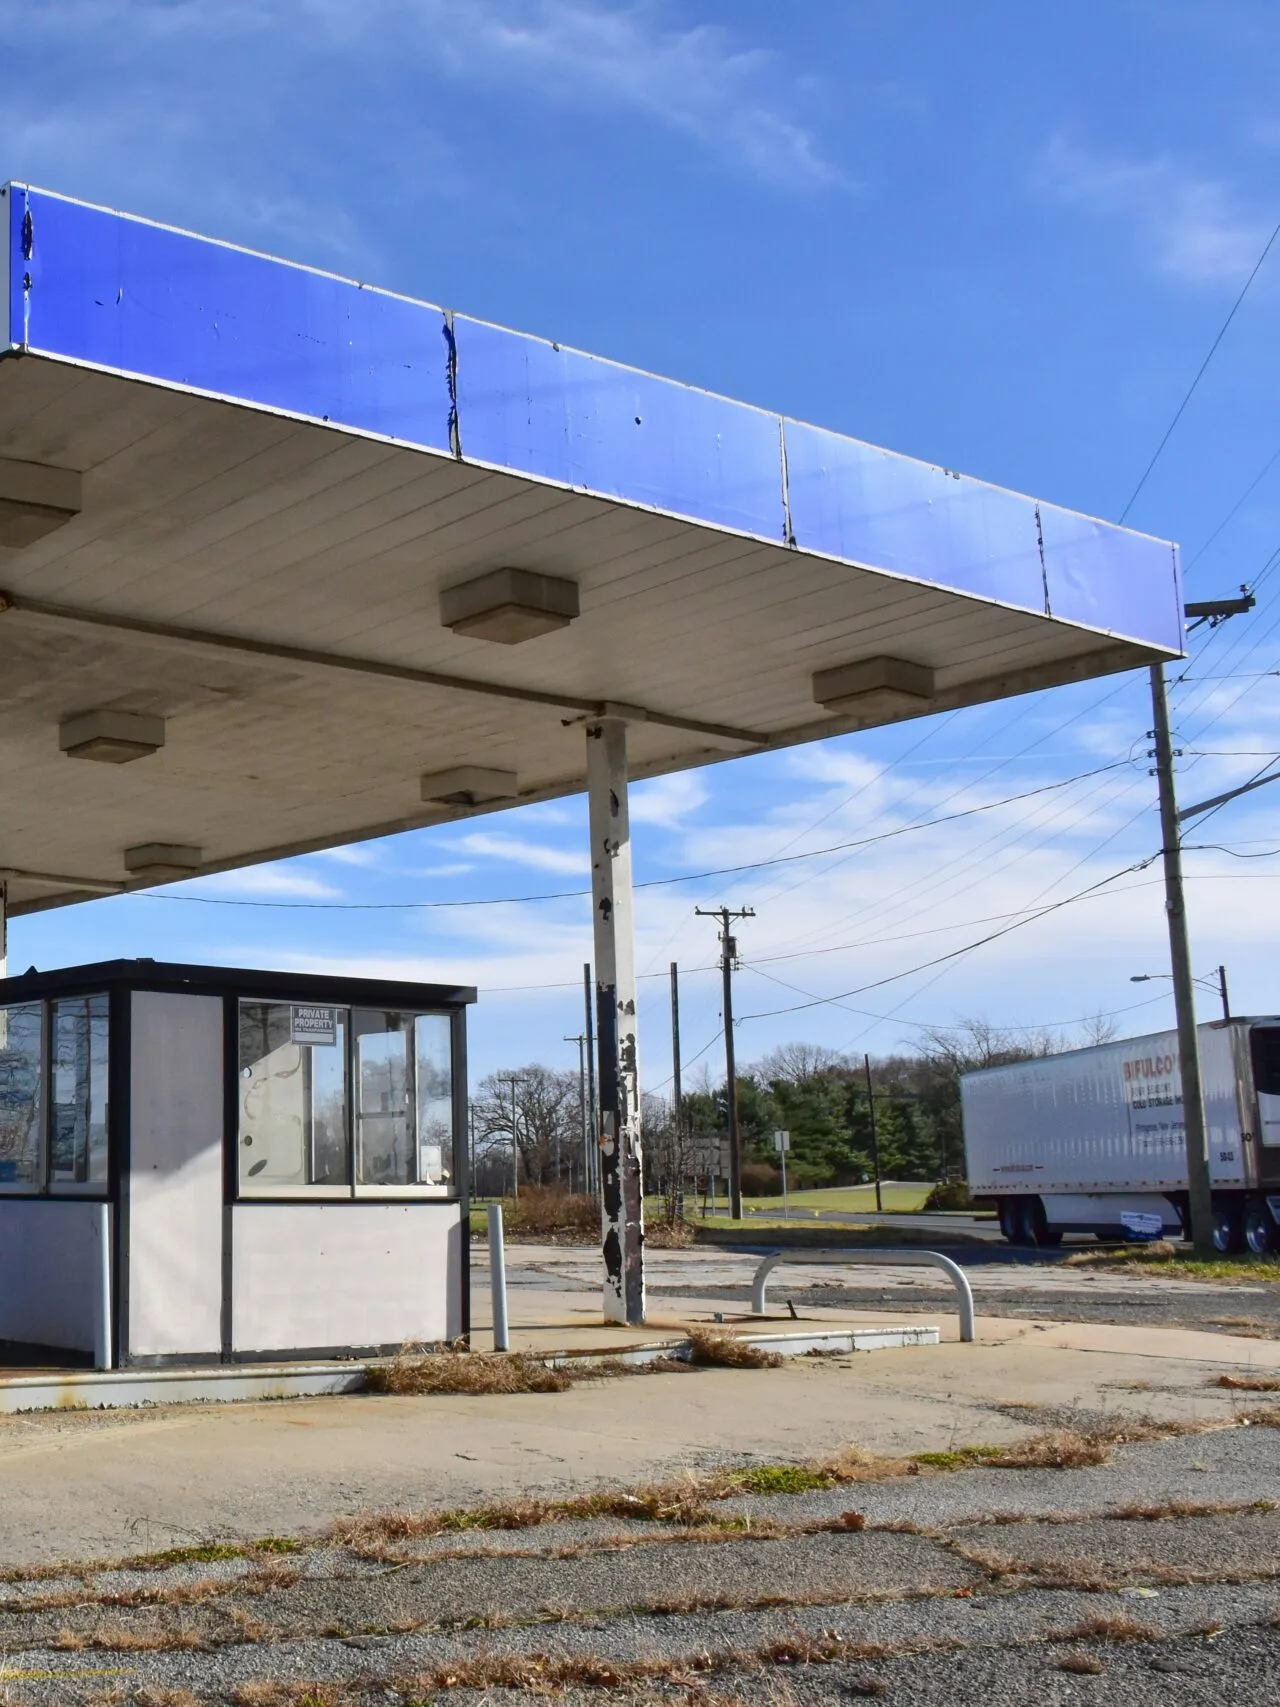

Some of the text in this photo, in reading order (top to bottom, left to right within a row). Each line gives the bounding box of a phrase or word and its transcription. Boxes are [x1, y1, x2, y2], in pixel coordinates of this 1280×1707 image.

[298, 1009, 329, 1019] PRIVATE
[295, 1018, 332, 1028] PROPERTY
[1123, 1054, 1183, 1081] BIFULCO'
